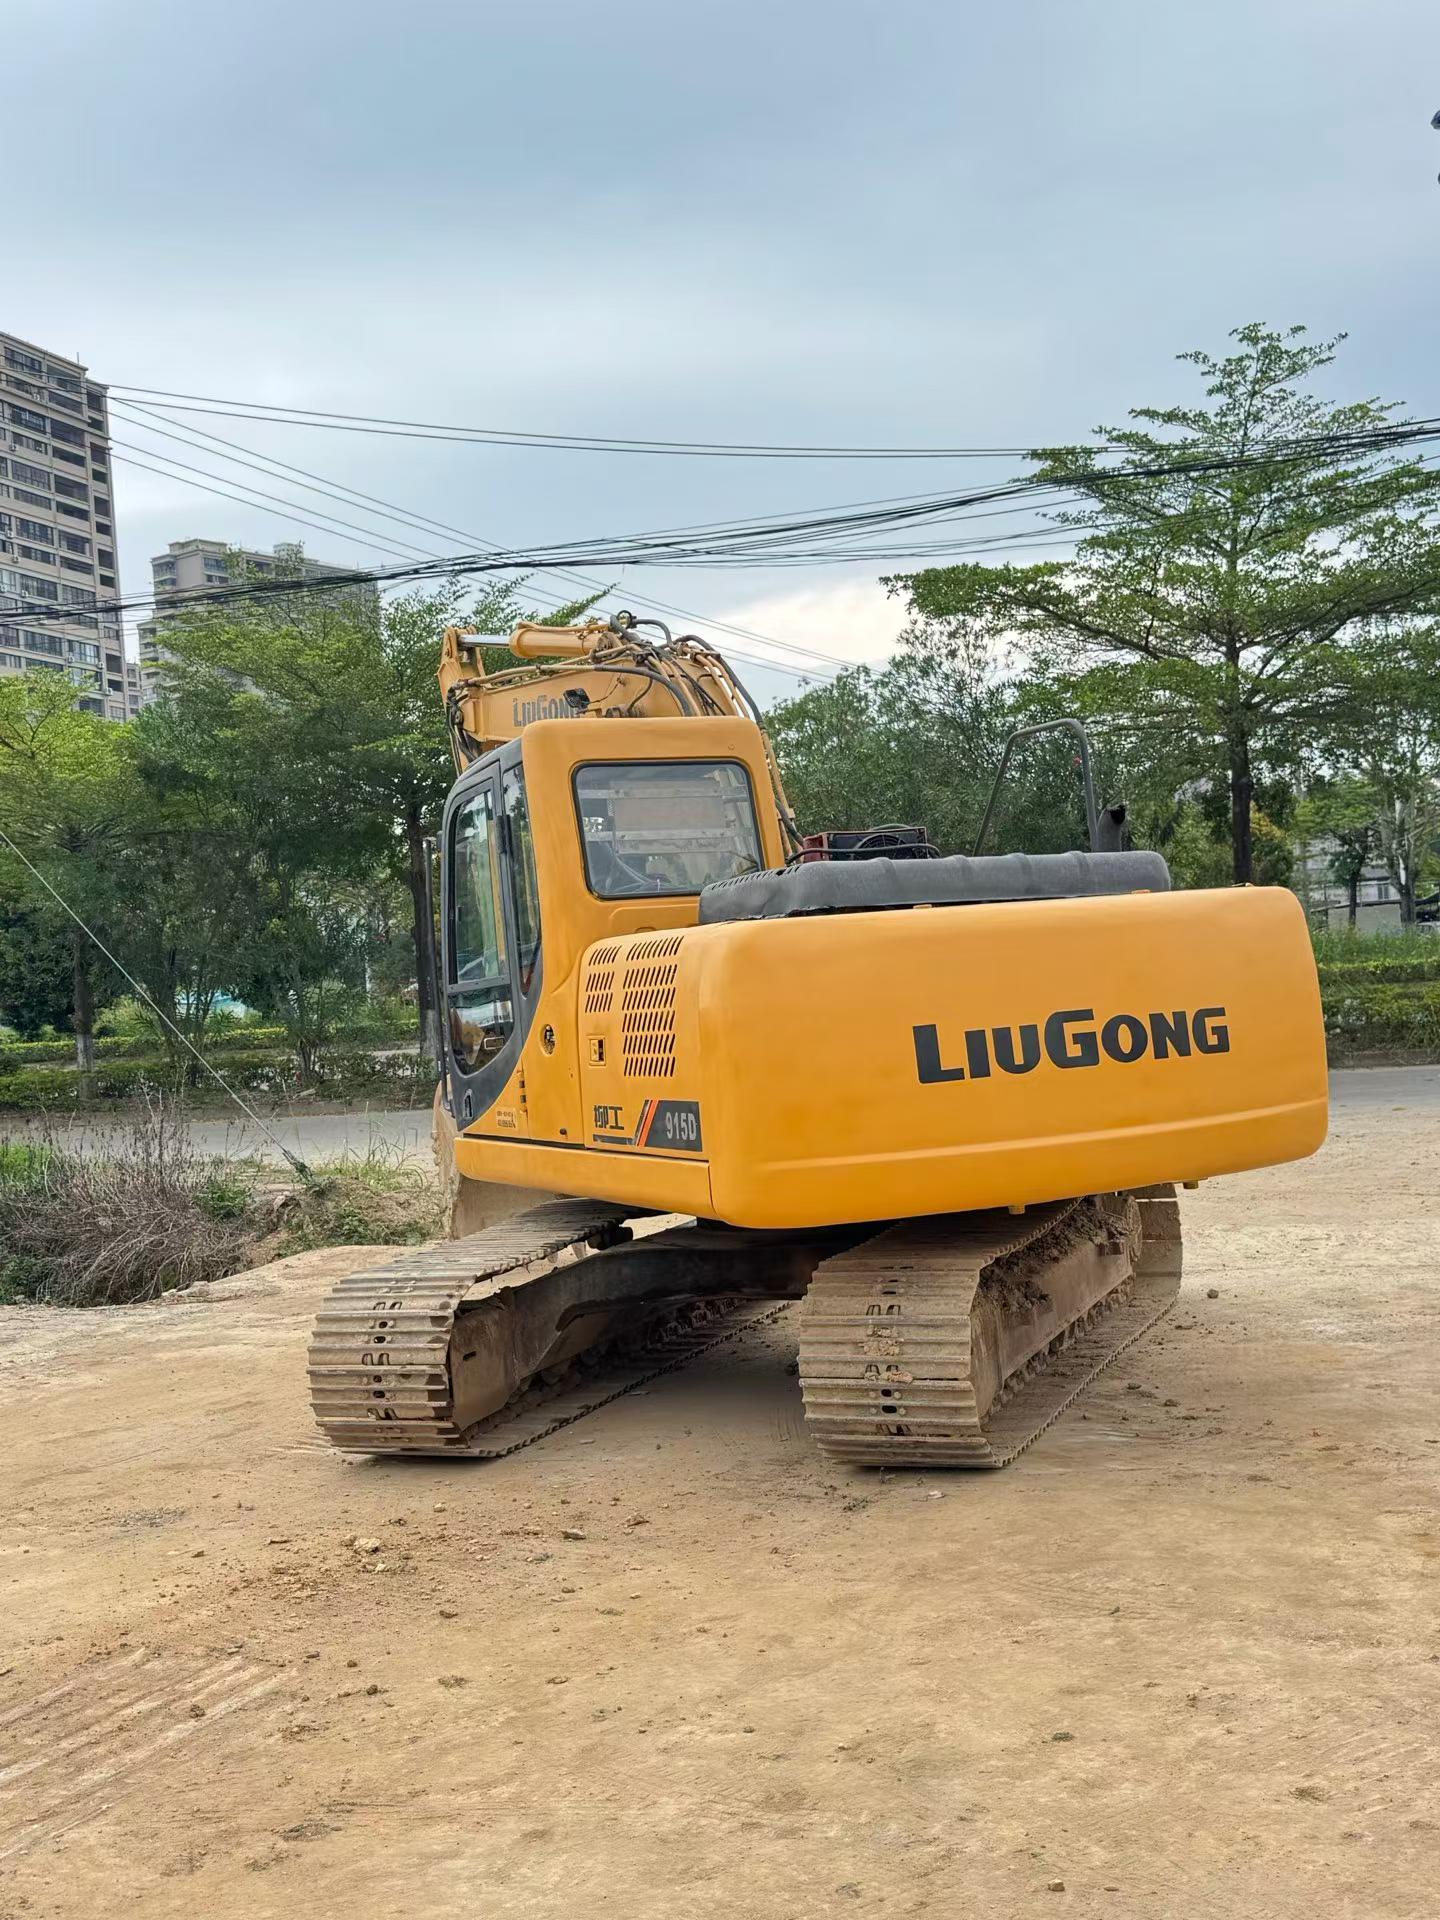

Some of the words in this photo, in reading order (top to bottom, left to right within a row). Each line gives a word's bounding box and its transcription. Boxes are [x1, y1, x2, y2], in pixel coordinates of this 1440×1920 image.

[513, 695, 580, 727] LIUGON
[594, 1105, 624, 1131] 柳工
[665, 1111, 697, 1141] 915D
